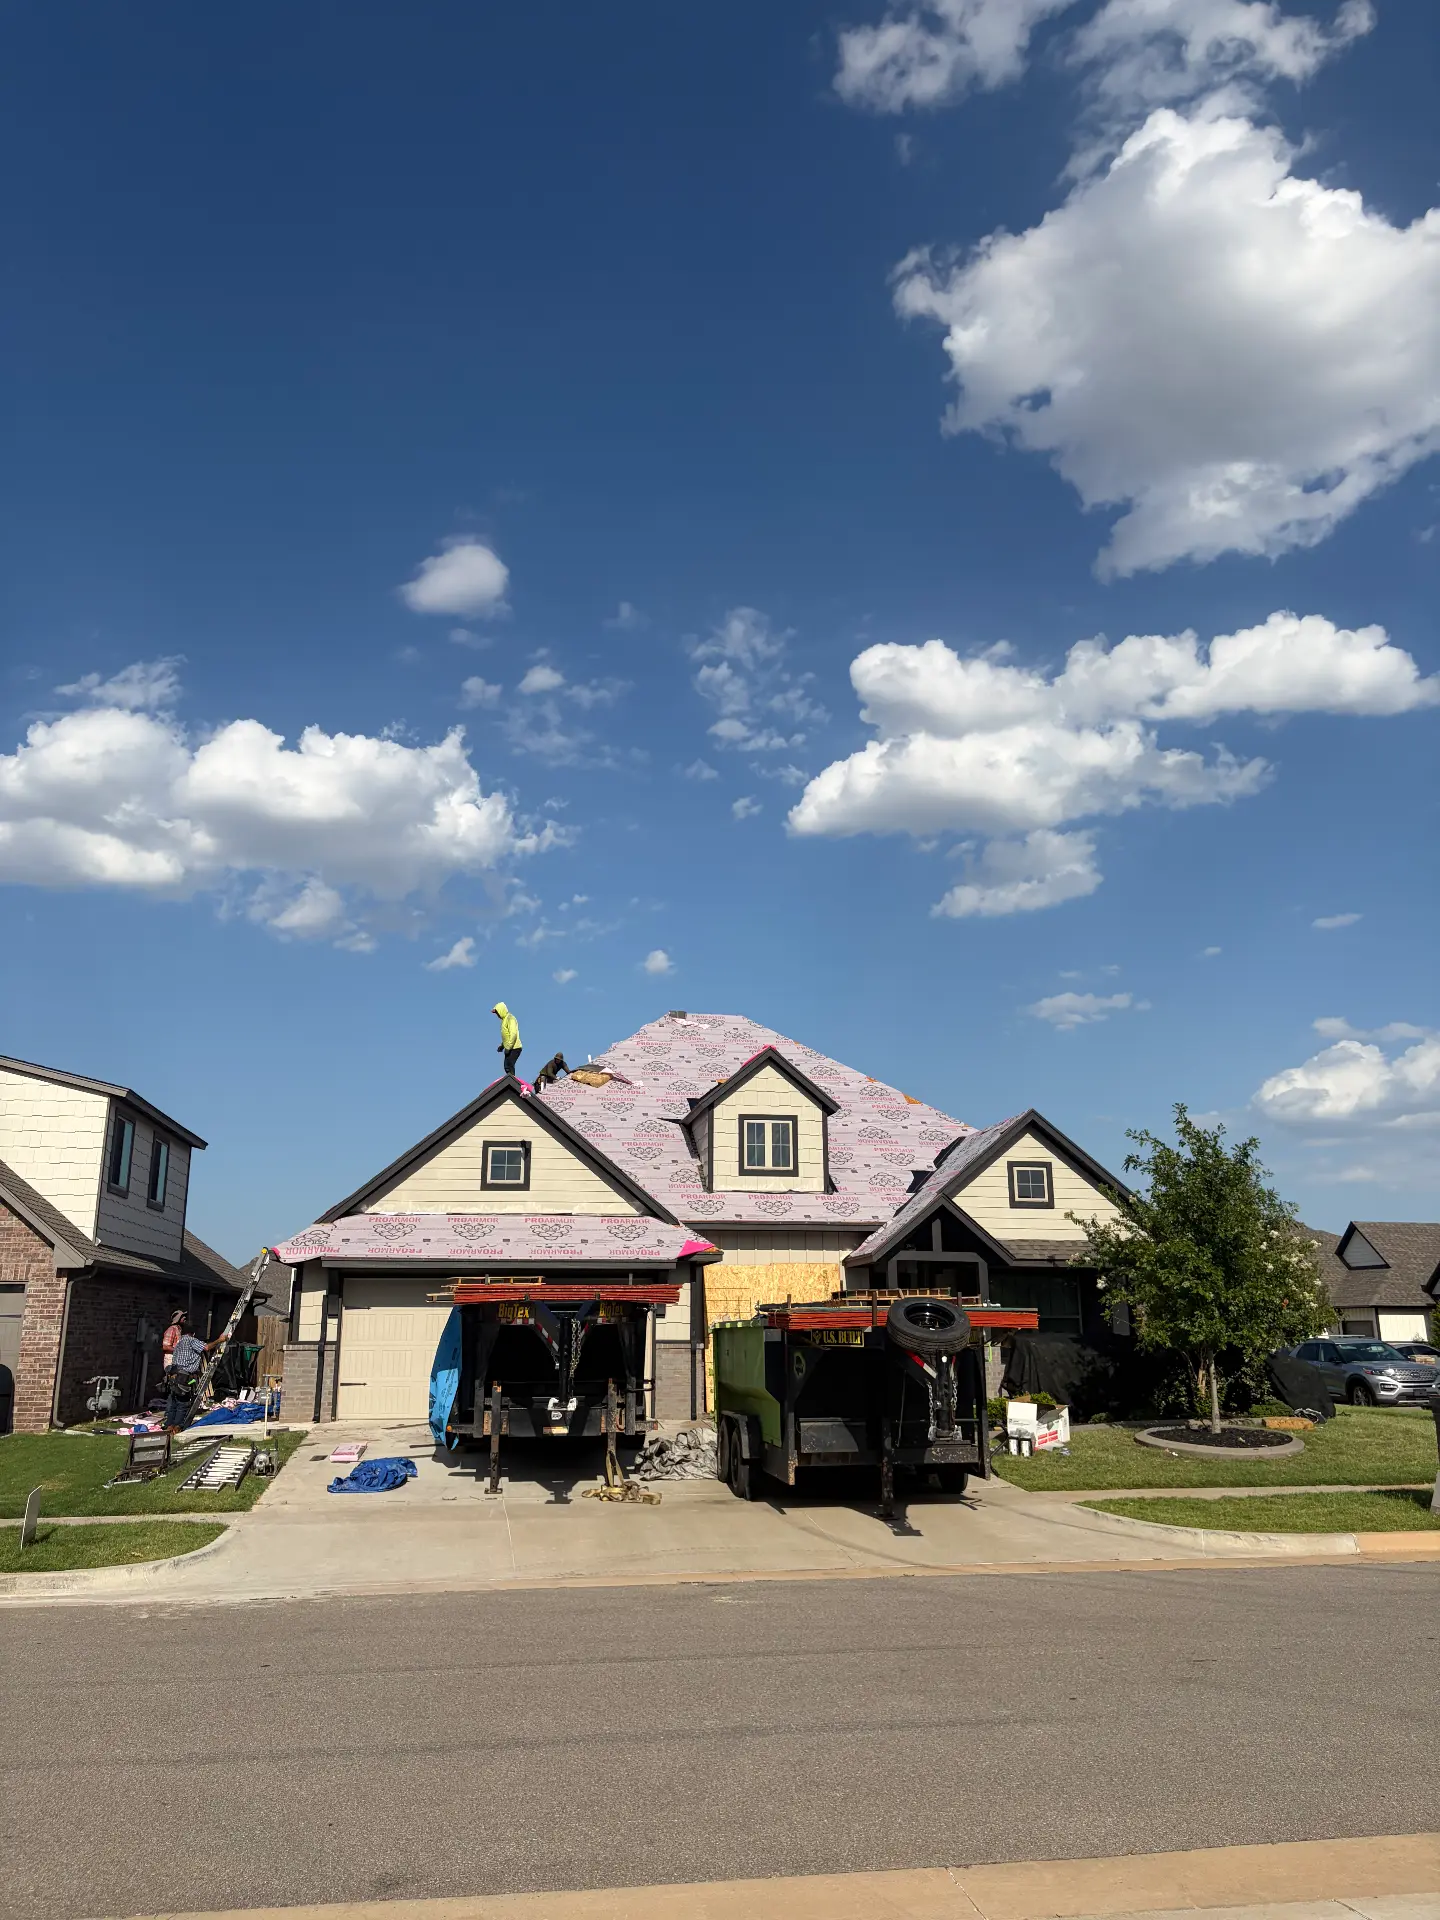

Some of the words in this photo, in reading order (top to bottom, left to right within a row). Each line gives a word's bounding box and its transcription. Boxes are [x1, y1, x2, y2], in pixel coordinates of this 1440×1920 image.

[285, 1246, 341, 1256] PROARMOR
[367, 1246, 423, 1254] PROARMOR
[449, 1247, 504, 1255] PROARMOR
[529, 1247, 583, 1255] PROARMOR
[607, 1248, 661, 1256] PROARMOR
[823, 1330, 837, 1344] U.S.
[838, 1330, 862, 1344] BUILT
